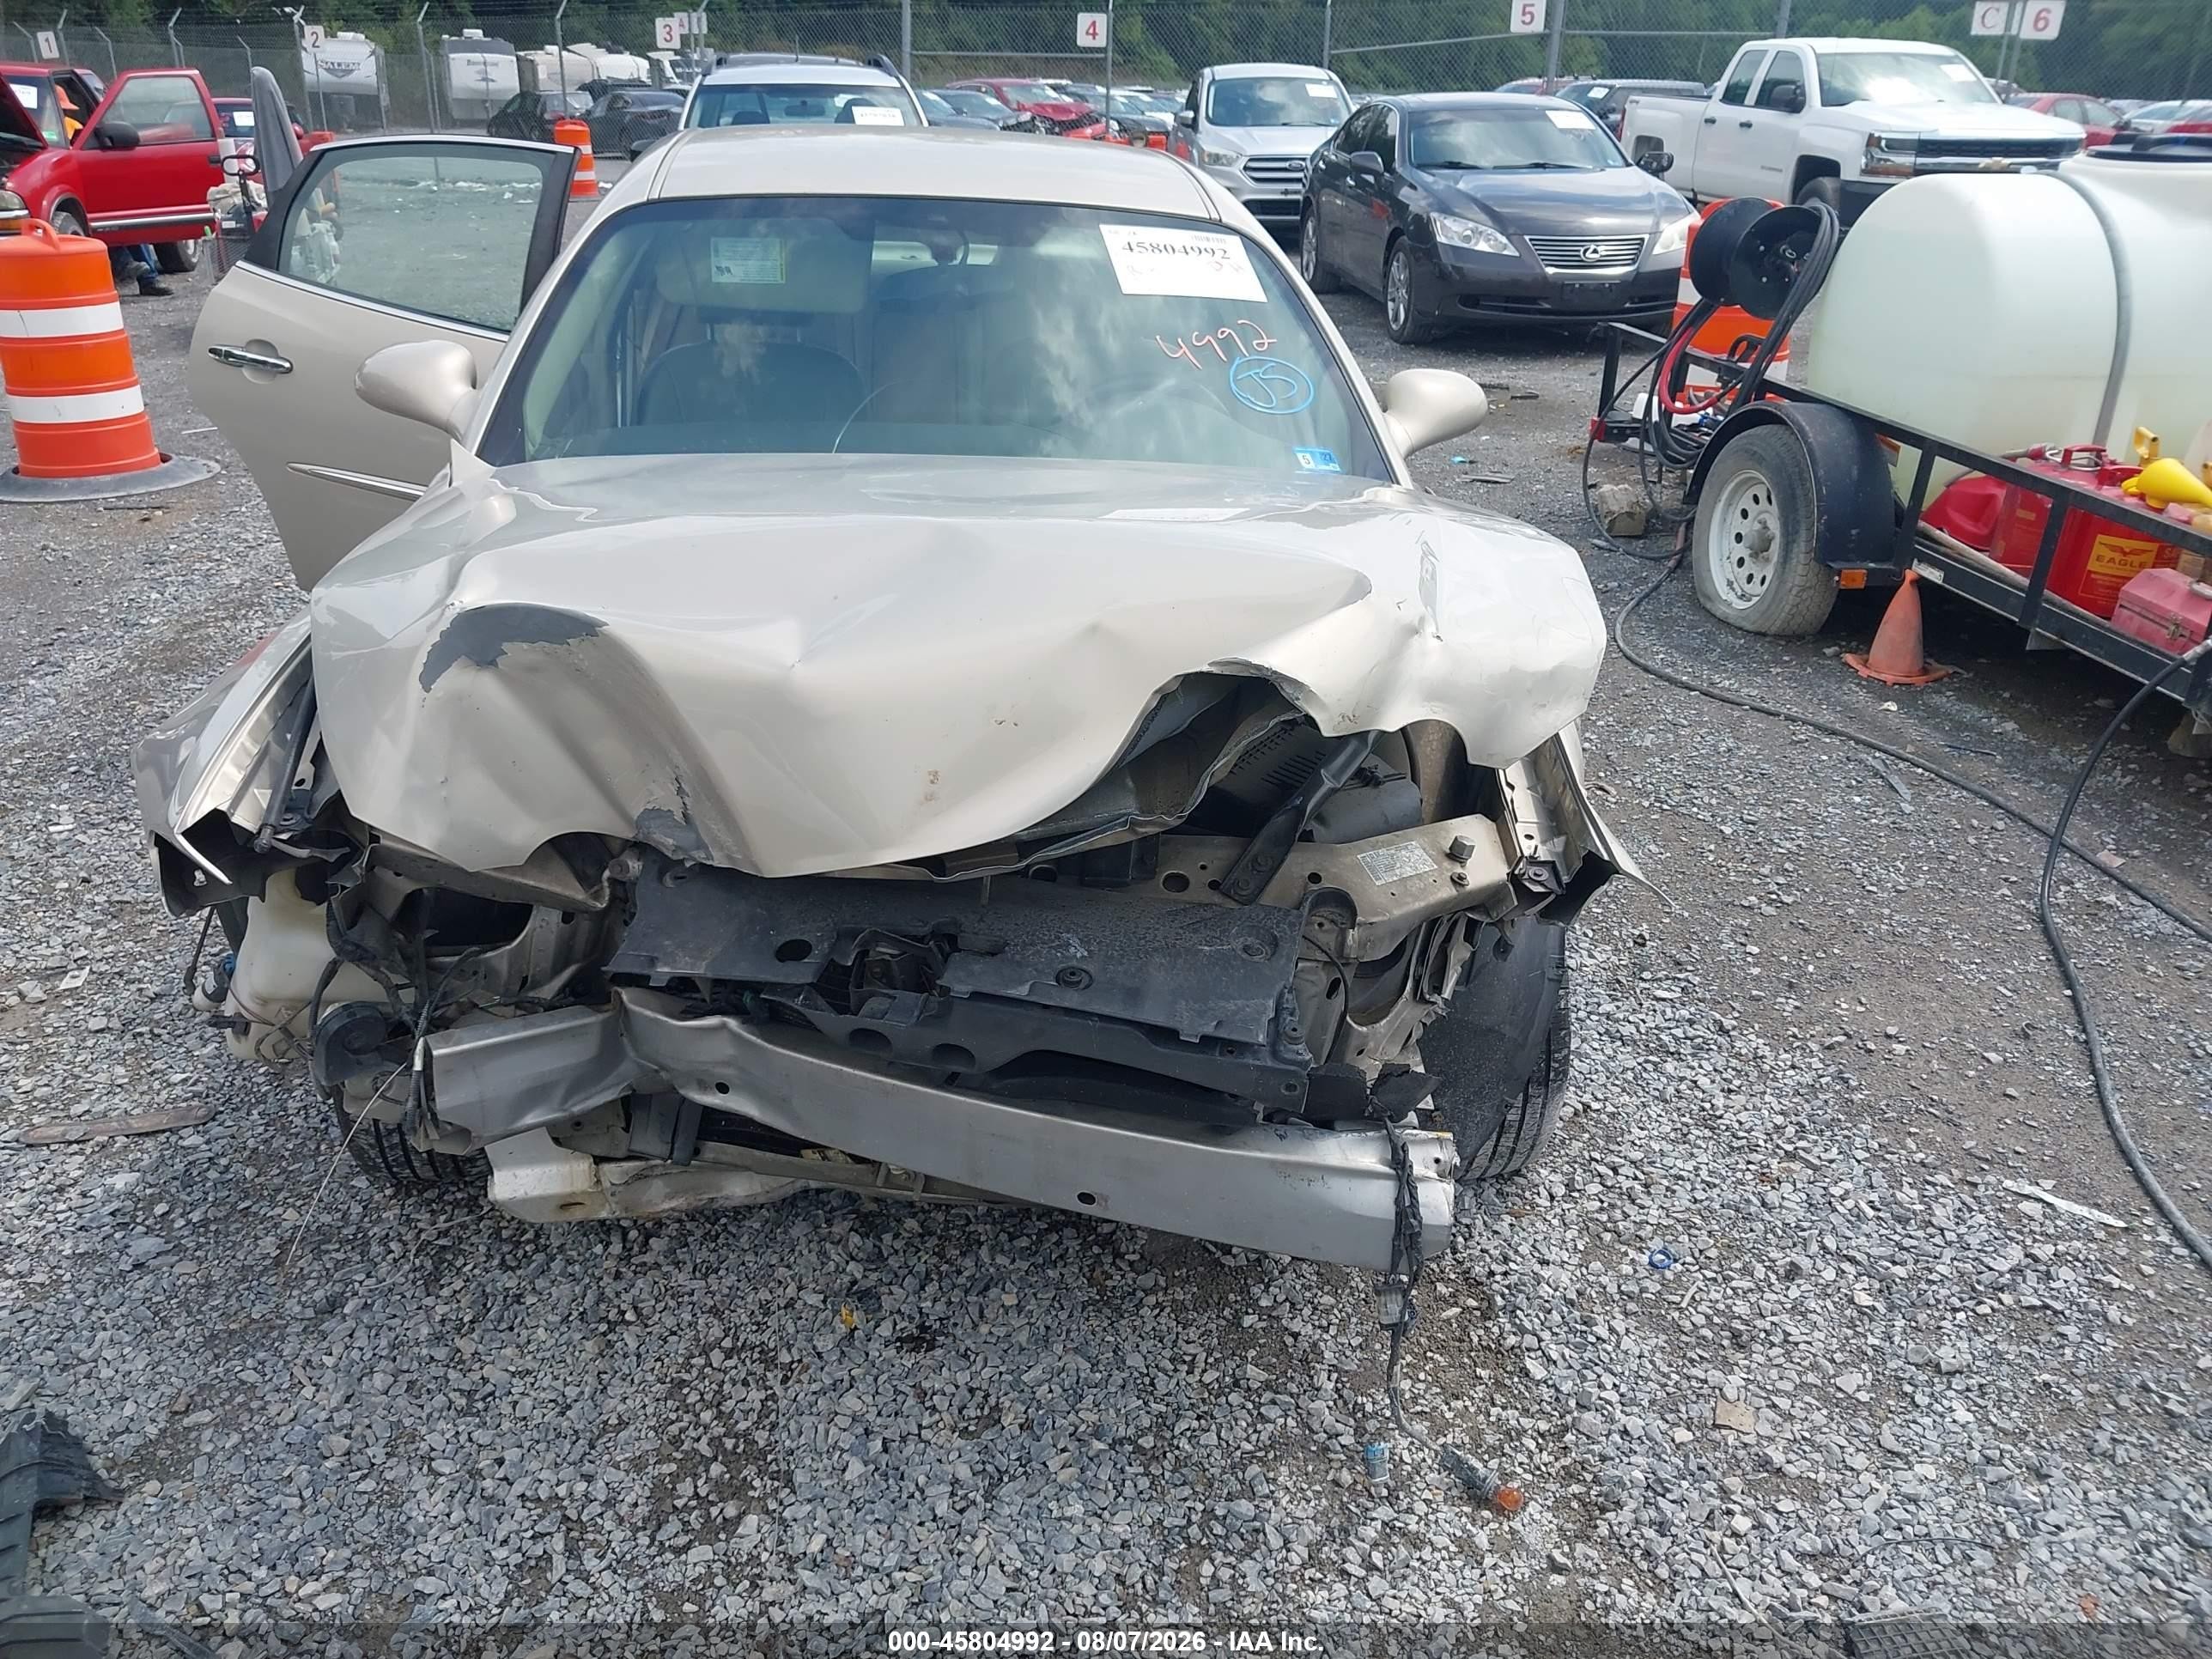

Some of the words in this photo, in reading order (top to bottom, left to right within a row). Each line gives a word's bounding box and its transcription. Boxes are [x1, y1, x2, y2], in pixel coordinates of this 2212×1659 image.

[678, 18, 686, 29] A
[1521, 3, 1535, 26] 5
[1980, 6, 2000, 29] C
[2033, 8, 2052, 32] 6
[311, 31, 320, 48] 2
[663, 23, 674, 43] 3
[1085, 20, 1100, 40] 4
[45, 36, 53, 54] 1
[1121, 240, 1231, 260] 45804992
[1156, 319, 1278, 370] 4992
[2095, 554, 2148, 568] EAGLE
